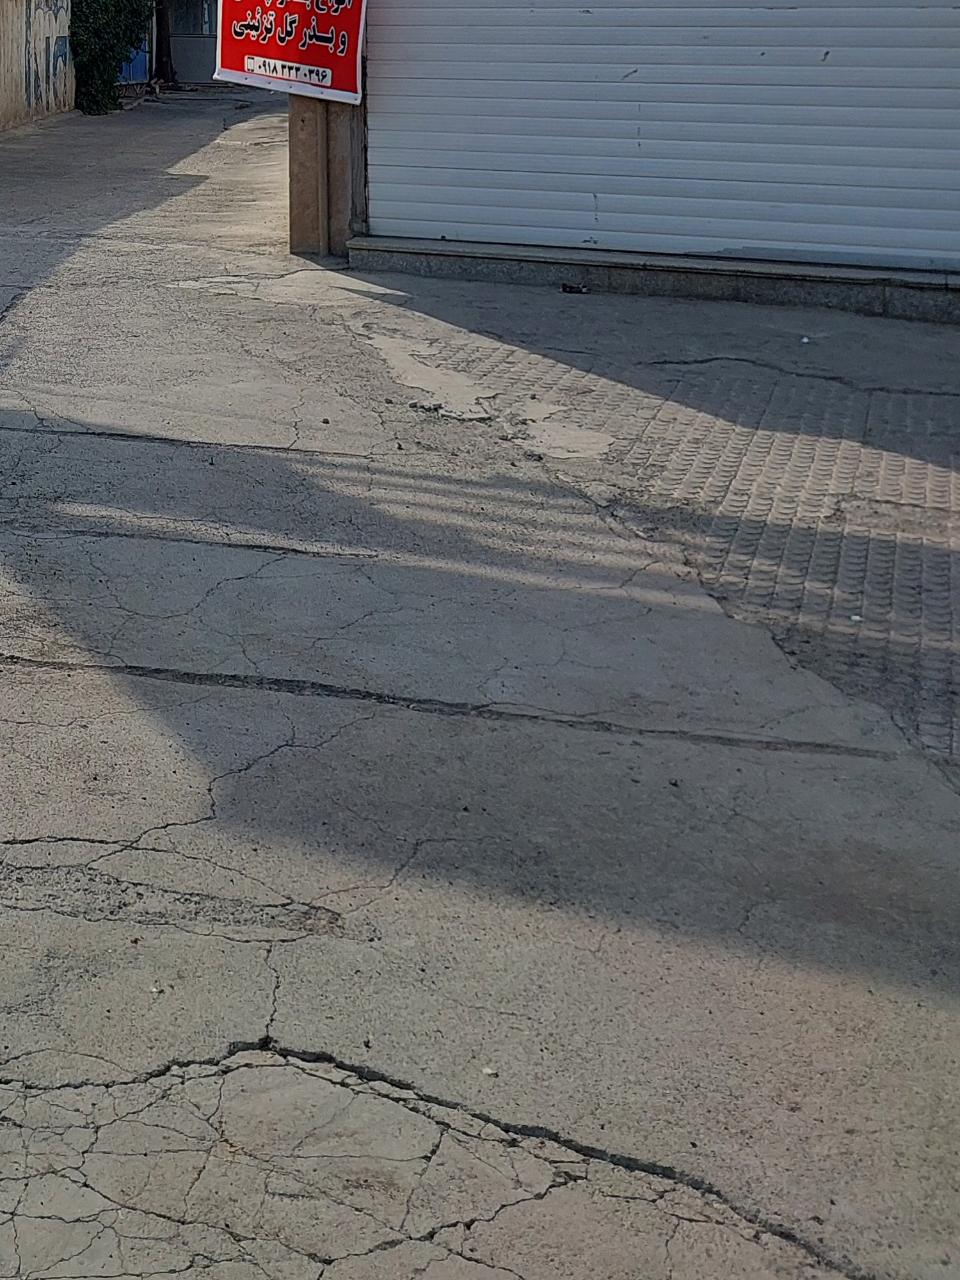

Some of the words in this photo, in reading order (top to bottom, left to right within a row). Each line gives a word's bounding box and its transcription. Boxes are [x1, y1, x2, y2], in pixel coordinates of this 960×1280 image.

[276, 12, 298, 45] گل
[299, 16, 336, 53] بذر
[337, 31, 348, 56] و
